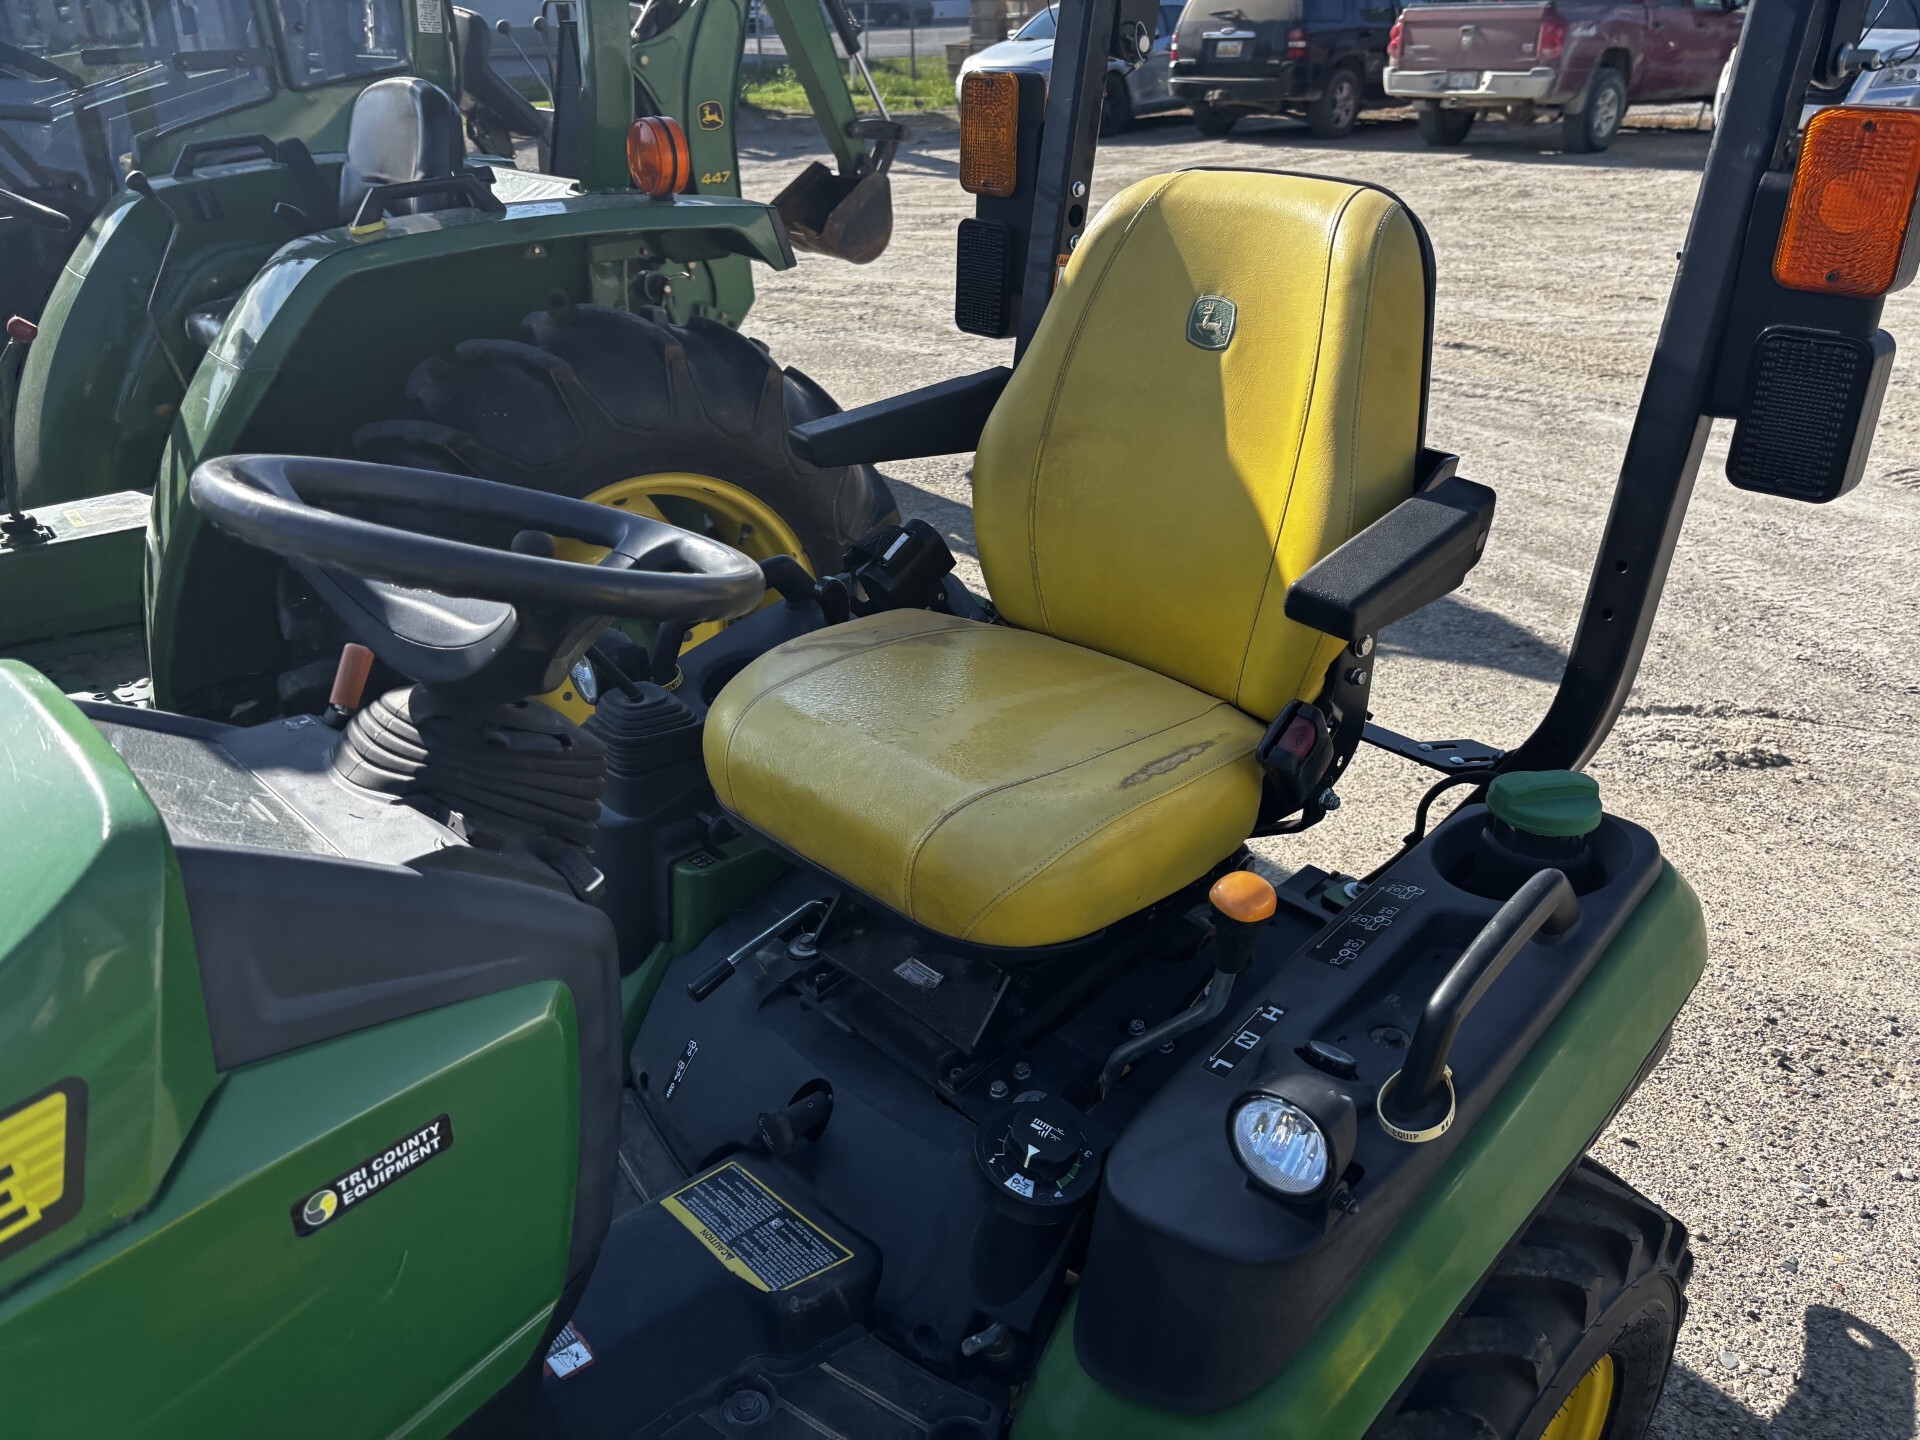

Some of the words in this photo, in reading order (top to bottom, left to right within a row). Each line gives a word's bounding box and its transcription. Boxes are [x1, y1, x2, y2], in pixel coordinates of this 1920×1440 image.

[701, 170, 731, 185] 447
[1261, 1005, 1284, 1022] H
[1235, 1031, 1261, 1050] N
[1211, 1058, 1234, 1069] L
[1392, 1129, 1419, 1140] EQUIP
[337, 1167, 368, 1192] TRI
[372, 1122, 440, 1172] COUNTY
[342, 1136, 441, 1205] EQUIPMENT
[700, 1229, 728, 1256] CAUTION
